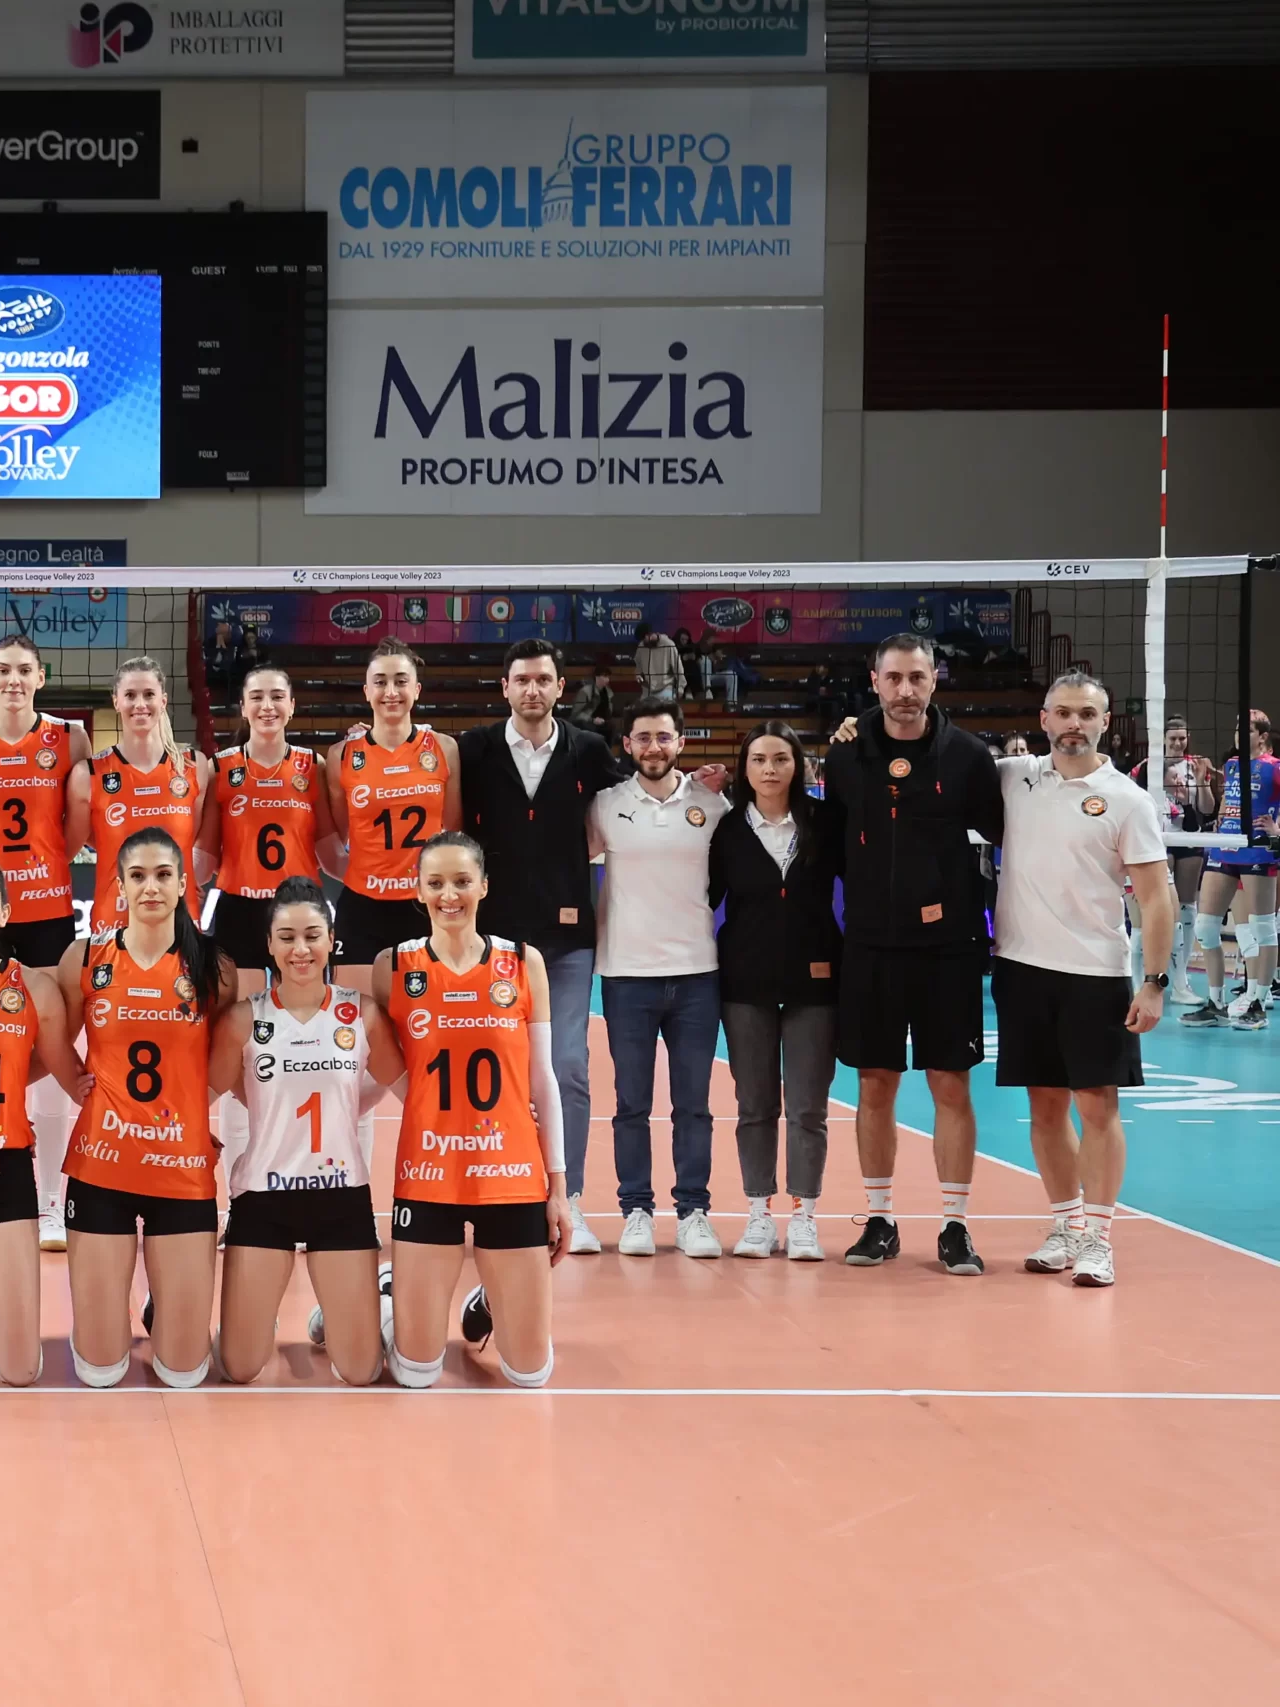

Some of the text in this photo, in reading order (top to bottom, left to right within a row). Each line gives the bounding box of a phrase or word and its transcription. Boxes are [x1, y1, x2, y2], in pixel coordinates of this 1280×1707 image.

[169, 10, 284, 31] IMBALLAGGI
[655, 17, 800, 34] by PROBIOTICAL
[169, 35, 283, 56] PROTETTIVI
[572, 133, 731, 165] GRUPPO
[339, 164, 793, 230] COMOLI FERRARI
[339, 239, 791, 259] DAL 1929 FORNITURE E SOLUZIONI PER IMPIANTI
[191, 265, 227, 275] GUEST
[374, 338, 752, 440] Malizia
[401, 457, 724, 486] PROFUMO D'INTESA
[47, 542, 104, 562] Lealtà
[25, 572, 51, 582] League
[53, 572, 76, 582] Volley
[77, 572, 95, 580] 2023
[312, 572, 441, 582] CEV Champions League Volley 2023
[659, 570, 791, 580] CEV Champions League Volley 2023
[1064, 564, 1090, 575] CEV
[7, 599, 106, 643] Volley
[540, 627, 547, 638] 1
[376, 783, 441, 800] Eczacıbaşı
[131, 803, 191, 818] Eczacıbaşı
[251, 797, 311, 812] Eczacıbaşı
[2, 798, 28, 840] 3
[373, 805, 426, 850] 12
[257, 823, 286, 871] 6
[20, 884, 71, 900] PEGASUS
[117, 1005, 204, 1027] Eczacıbaşı
[437, 1013, 518, 1032] Eczacıbaşı
[125, 1040, 163, 1103] 8
[282, 1056, 359, 1074] Eczacıbaşı
[426, 1047, 502, 1112] 10
[101, 1109, 185, 1142] Dynavit
[296, 1091, 323, 1154] 1
[74, 1134, 120, 1164] Selin
[422, 1130, 505, 1156] Dynavit
[140, 1152, 207, 1169] PEGASUS
[400, 1159, 445, 1182] Selin
[465, 1162, 532, 1178] PEGASUS
[267, 1168, 350, 1191] Dynavit
[67, 1199, 75, 1219] 8
[394, 1207, 412, 1228] 10
